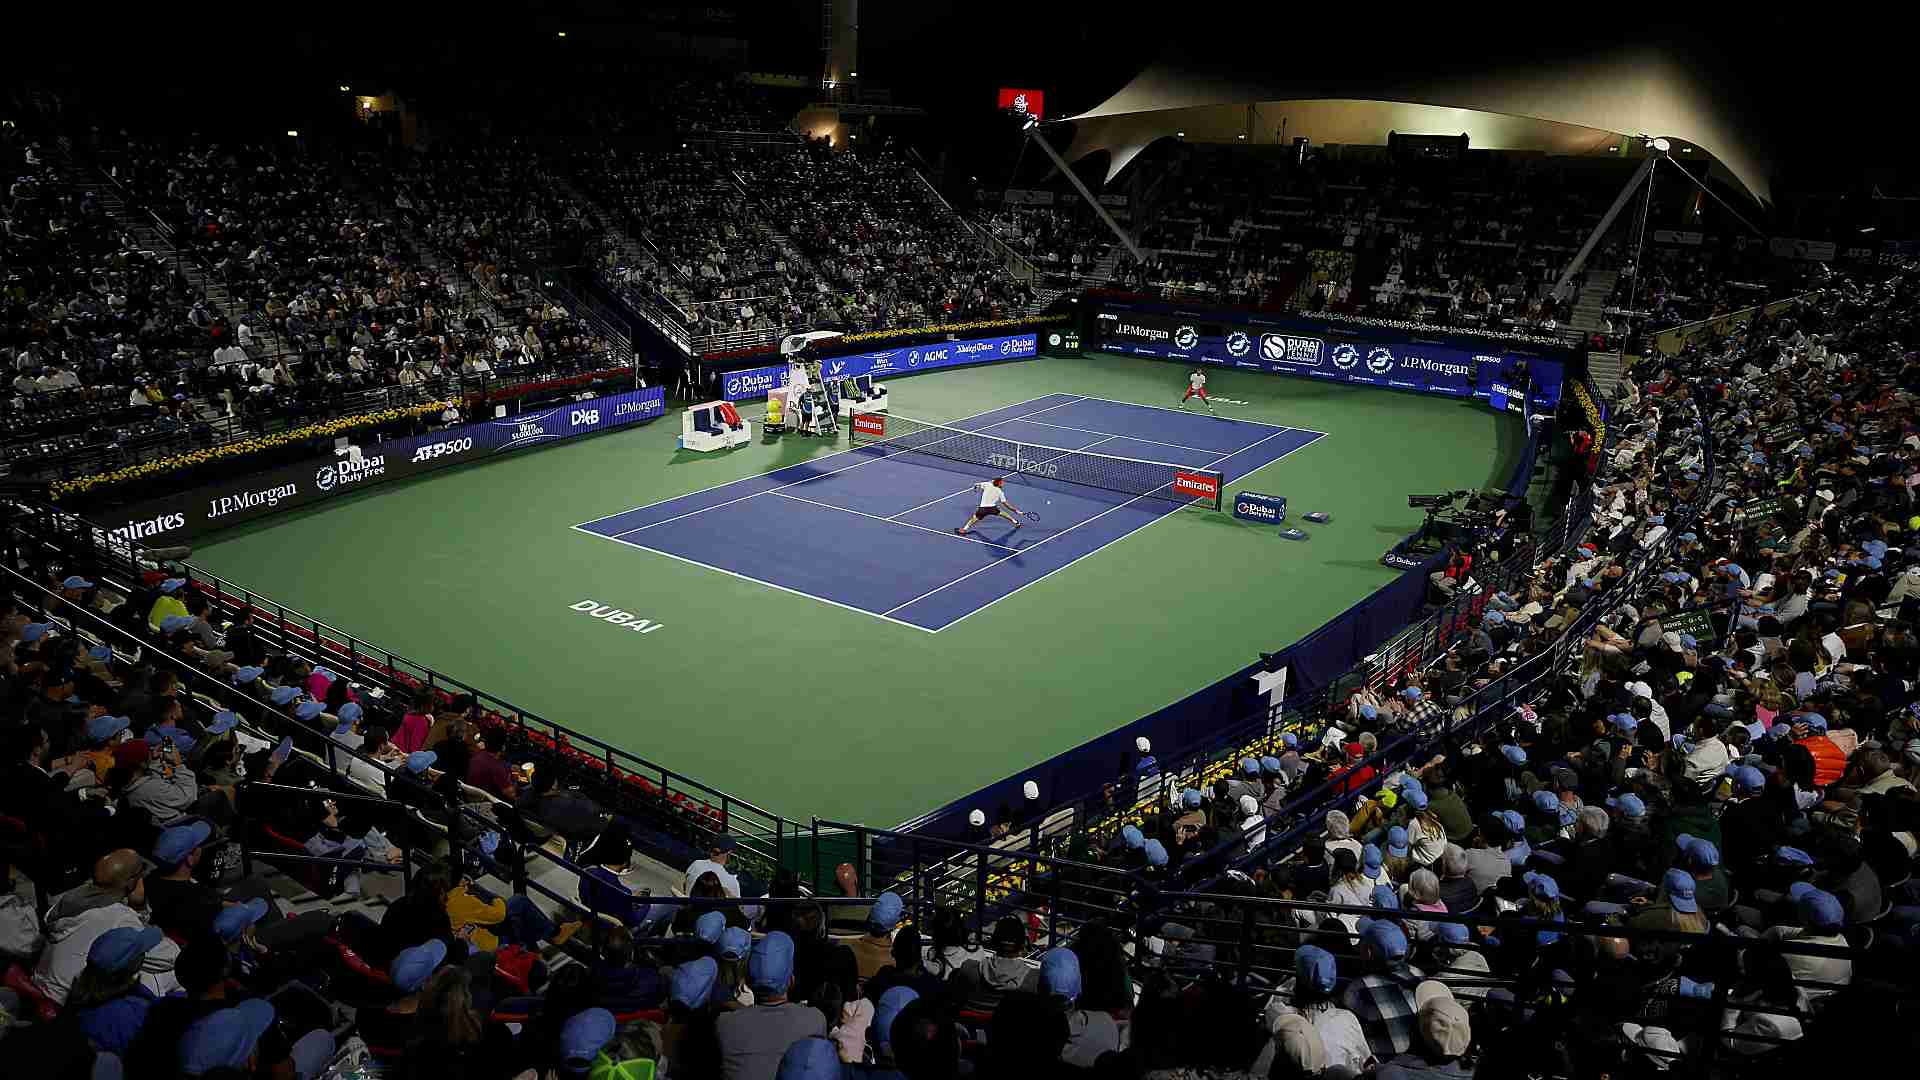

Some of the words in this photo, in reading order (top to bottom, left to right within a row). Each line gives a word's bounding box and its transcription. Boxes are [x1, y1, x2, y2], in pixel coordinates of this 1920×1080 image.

[1115, 324, 1169, 341] J.P.Morgan
[1011, 338, 1034, 347] Dubai
[1287, 338, 1320, 349] DUBAI
[923, 350, 948, 362] AGMC
[1400, 357, 1469, 376] J.P.Morgan
[741, 375, 773, 388] Dubai
[758, 382, 773, 391] Free
[614, 398, 661, 417] J.P.Morgan
[519, 422, 536, 432] Win
[854, 418, 883, 430] Emirates
[1022, 457, 1057, 477] TOUR
[340, 472, 364, 485] Duty
[364, 467, 385, 478] Free
[1176, 477, 1215, 493] Emirates
[207, 482, 297, 518] J.P.Morgan
[1249, 503, 1276, 514] Dubai
[567, 599, 665, 633] DUBAI
